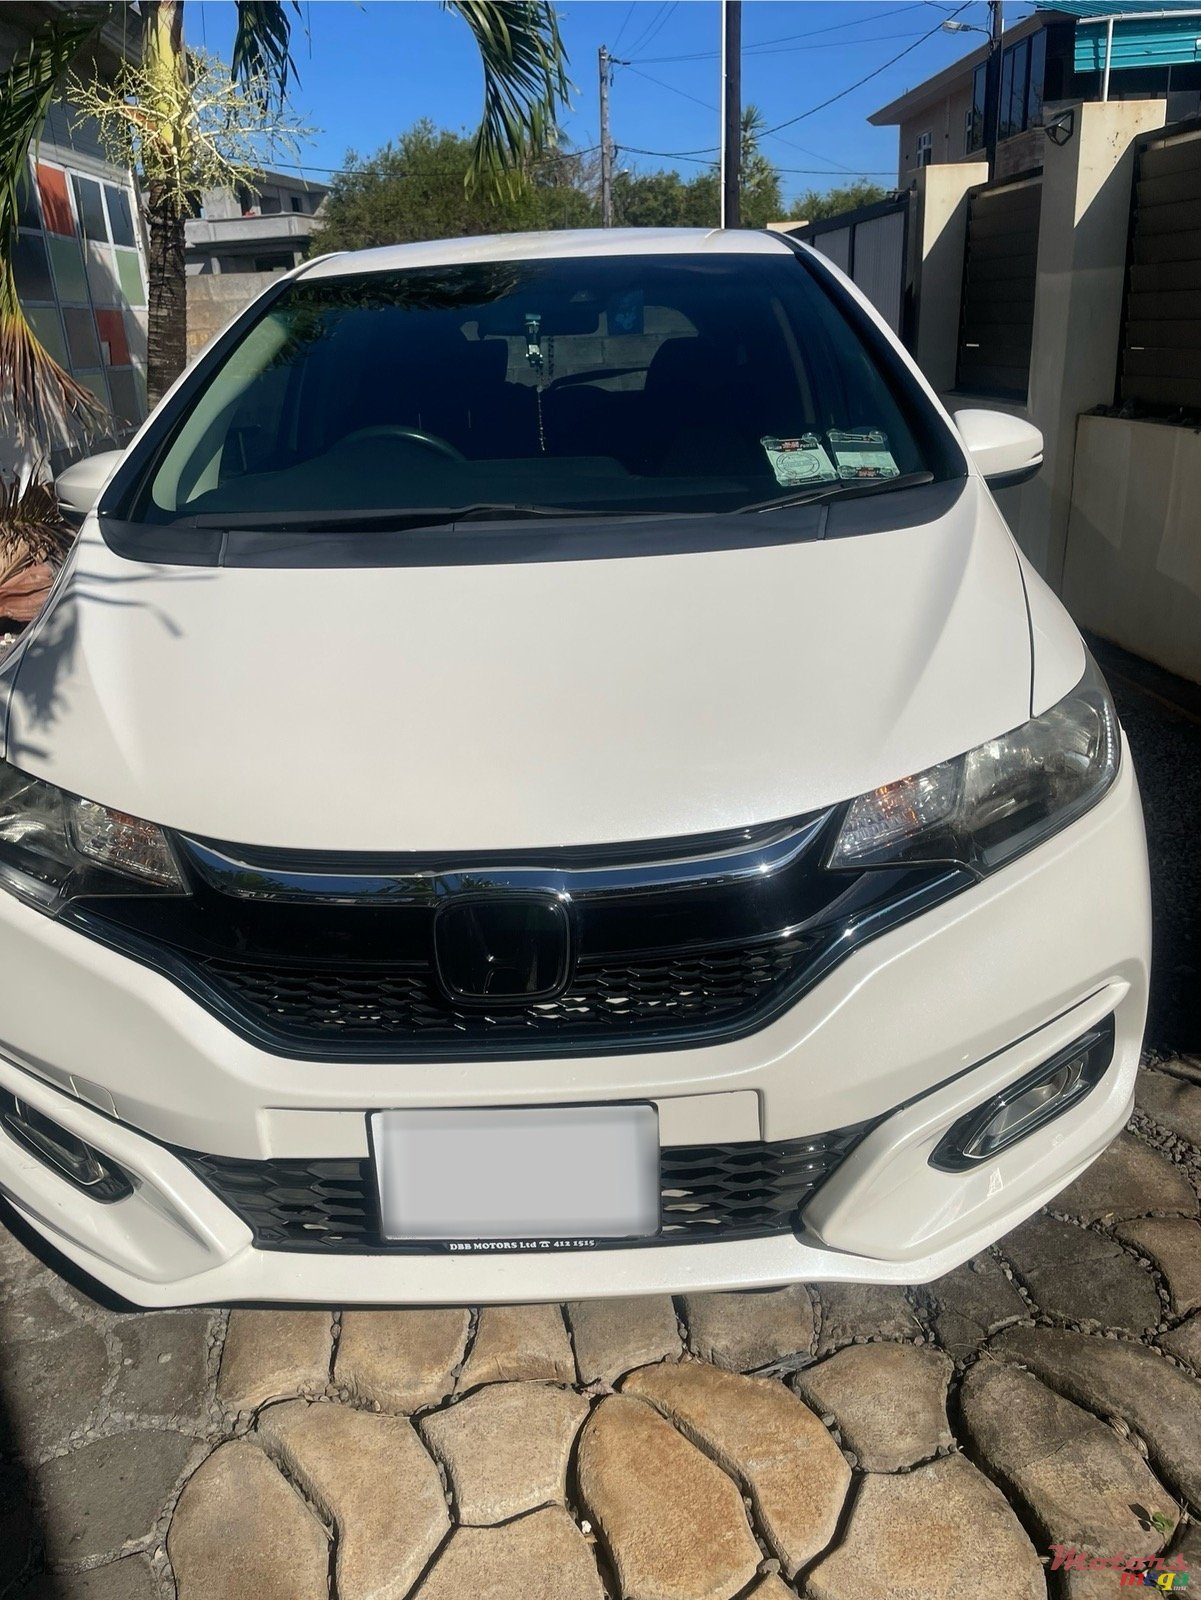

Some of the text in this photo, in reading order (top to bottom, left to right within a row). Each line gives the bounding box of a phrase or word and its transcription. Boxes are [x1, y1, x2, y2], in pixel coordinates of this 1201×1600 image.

[449, 1243, 472, 1251] DBB
[473, 1242, 518, 1250] MOTORS
[519, 1241, 537, 1249] Ltd
[553, 1240, 571, 1248] 412
